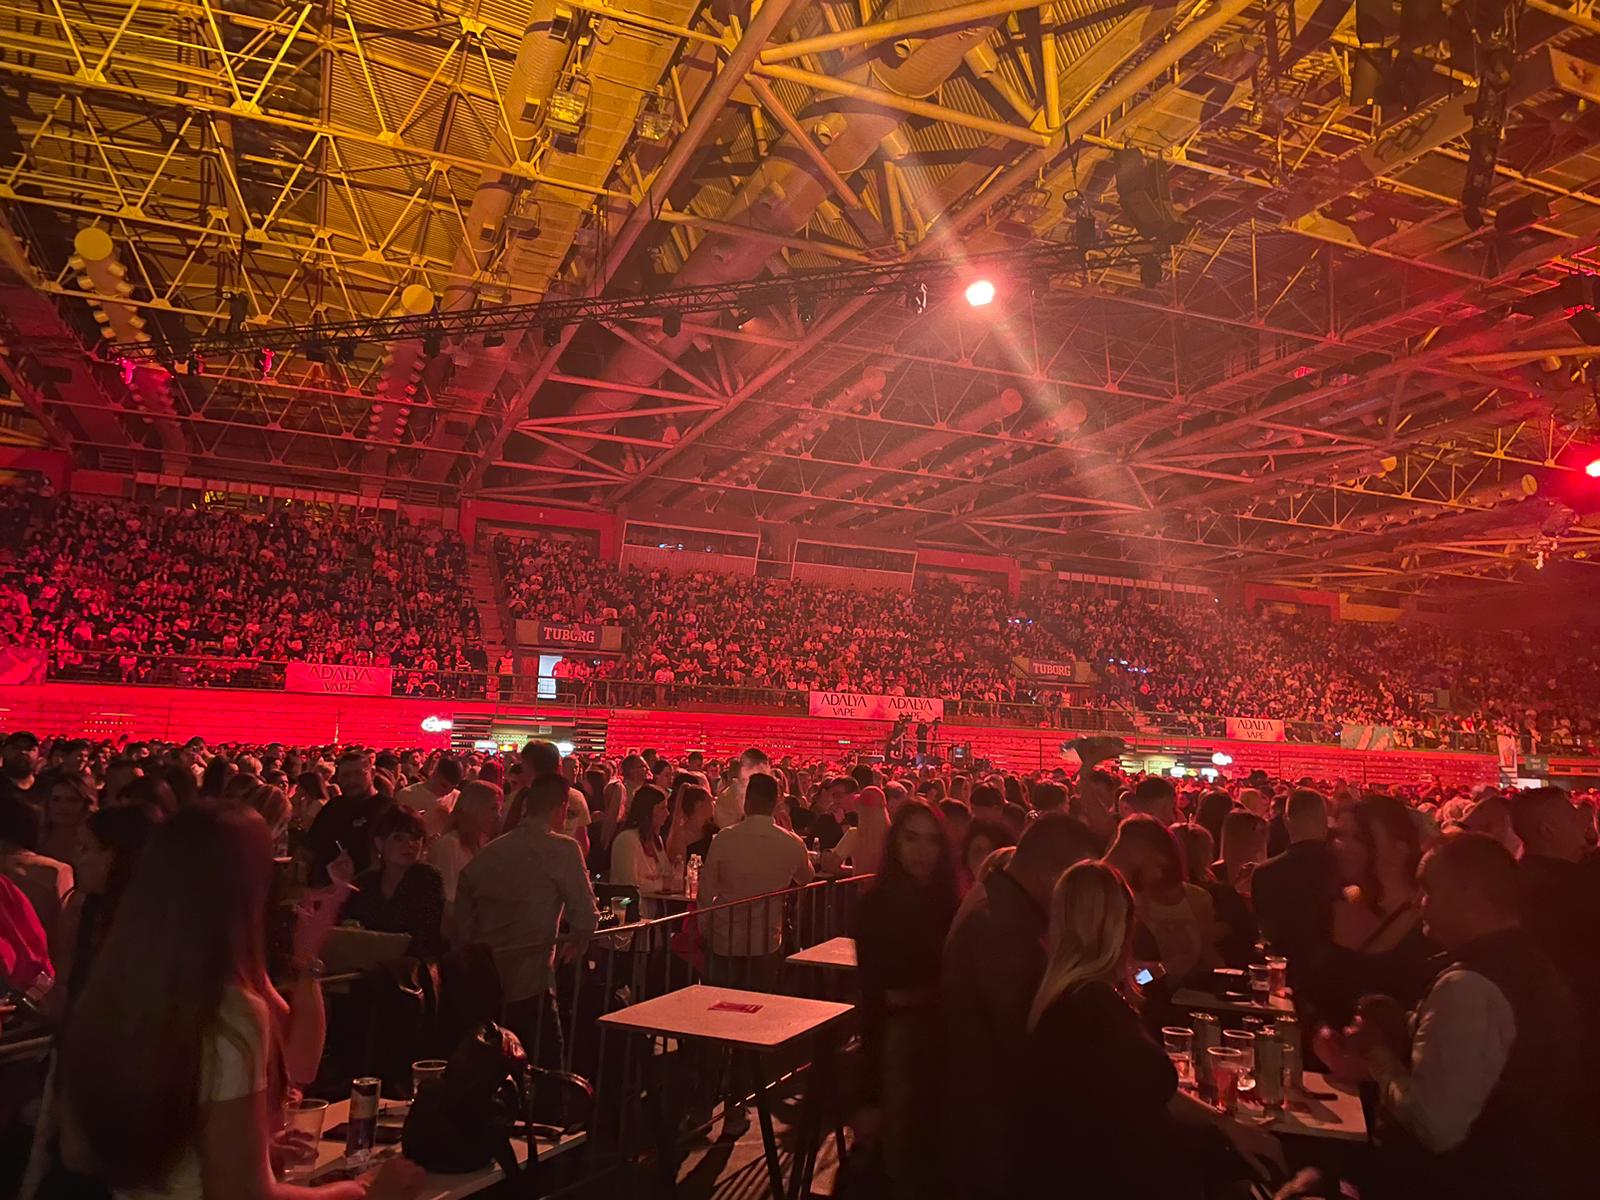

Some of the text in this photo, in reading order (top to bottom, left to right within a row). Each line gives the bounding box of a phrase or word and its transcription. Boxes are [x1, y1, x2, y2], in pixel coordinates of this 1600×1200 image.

[308, 666, 372, 681] ADALYA
[1032, 663, 1071, 676] TUBORG
[324, 681, 355, 692] VAPE
[821, 693, 867, 707] ADALYA
[888, 698, 933, 711] ADALYA
[832, 708, 855, 717] VAPE
[1238, 719, 1273, 731] ADALYA
[1246, 731, 1265, 739] VAPE
